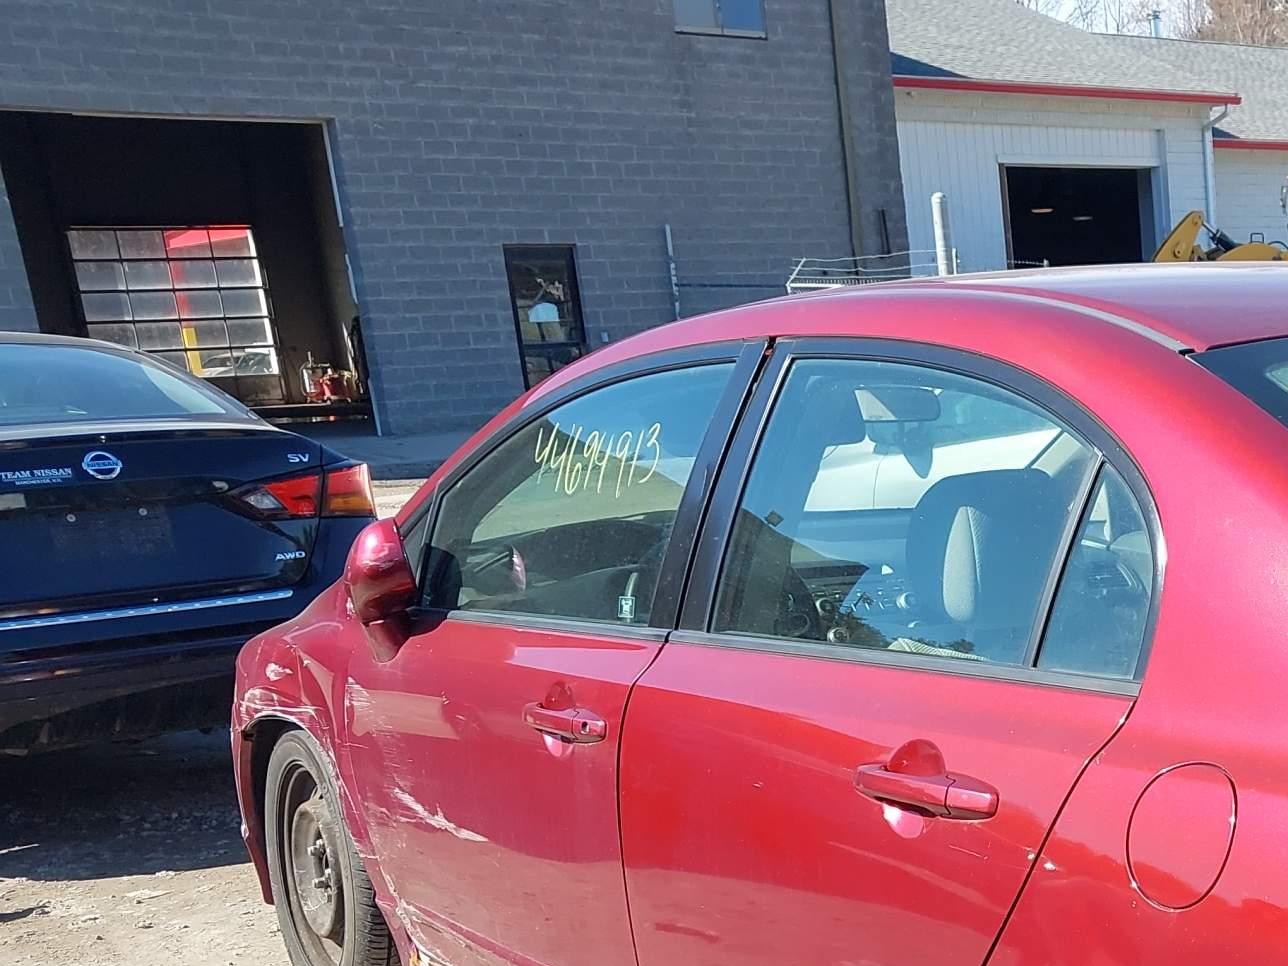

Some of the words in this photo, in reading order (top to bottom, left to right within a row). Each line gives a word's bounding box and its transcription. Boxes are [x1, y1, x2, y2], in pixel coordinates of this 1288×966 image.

[287, 453, 310, 463] SV
[534, 421, 662, 499] 44694913
[0, 470, 31, 480] TEAM
[33, 467, 72, 477] NISSAN
[275, 550, 306, 561] AWD
